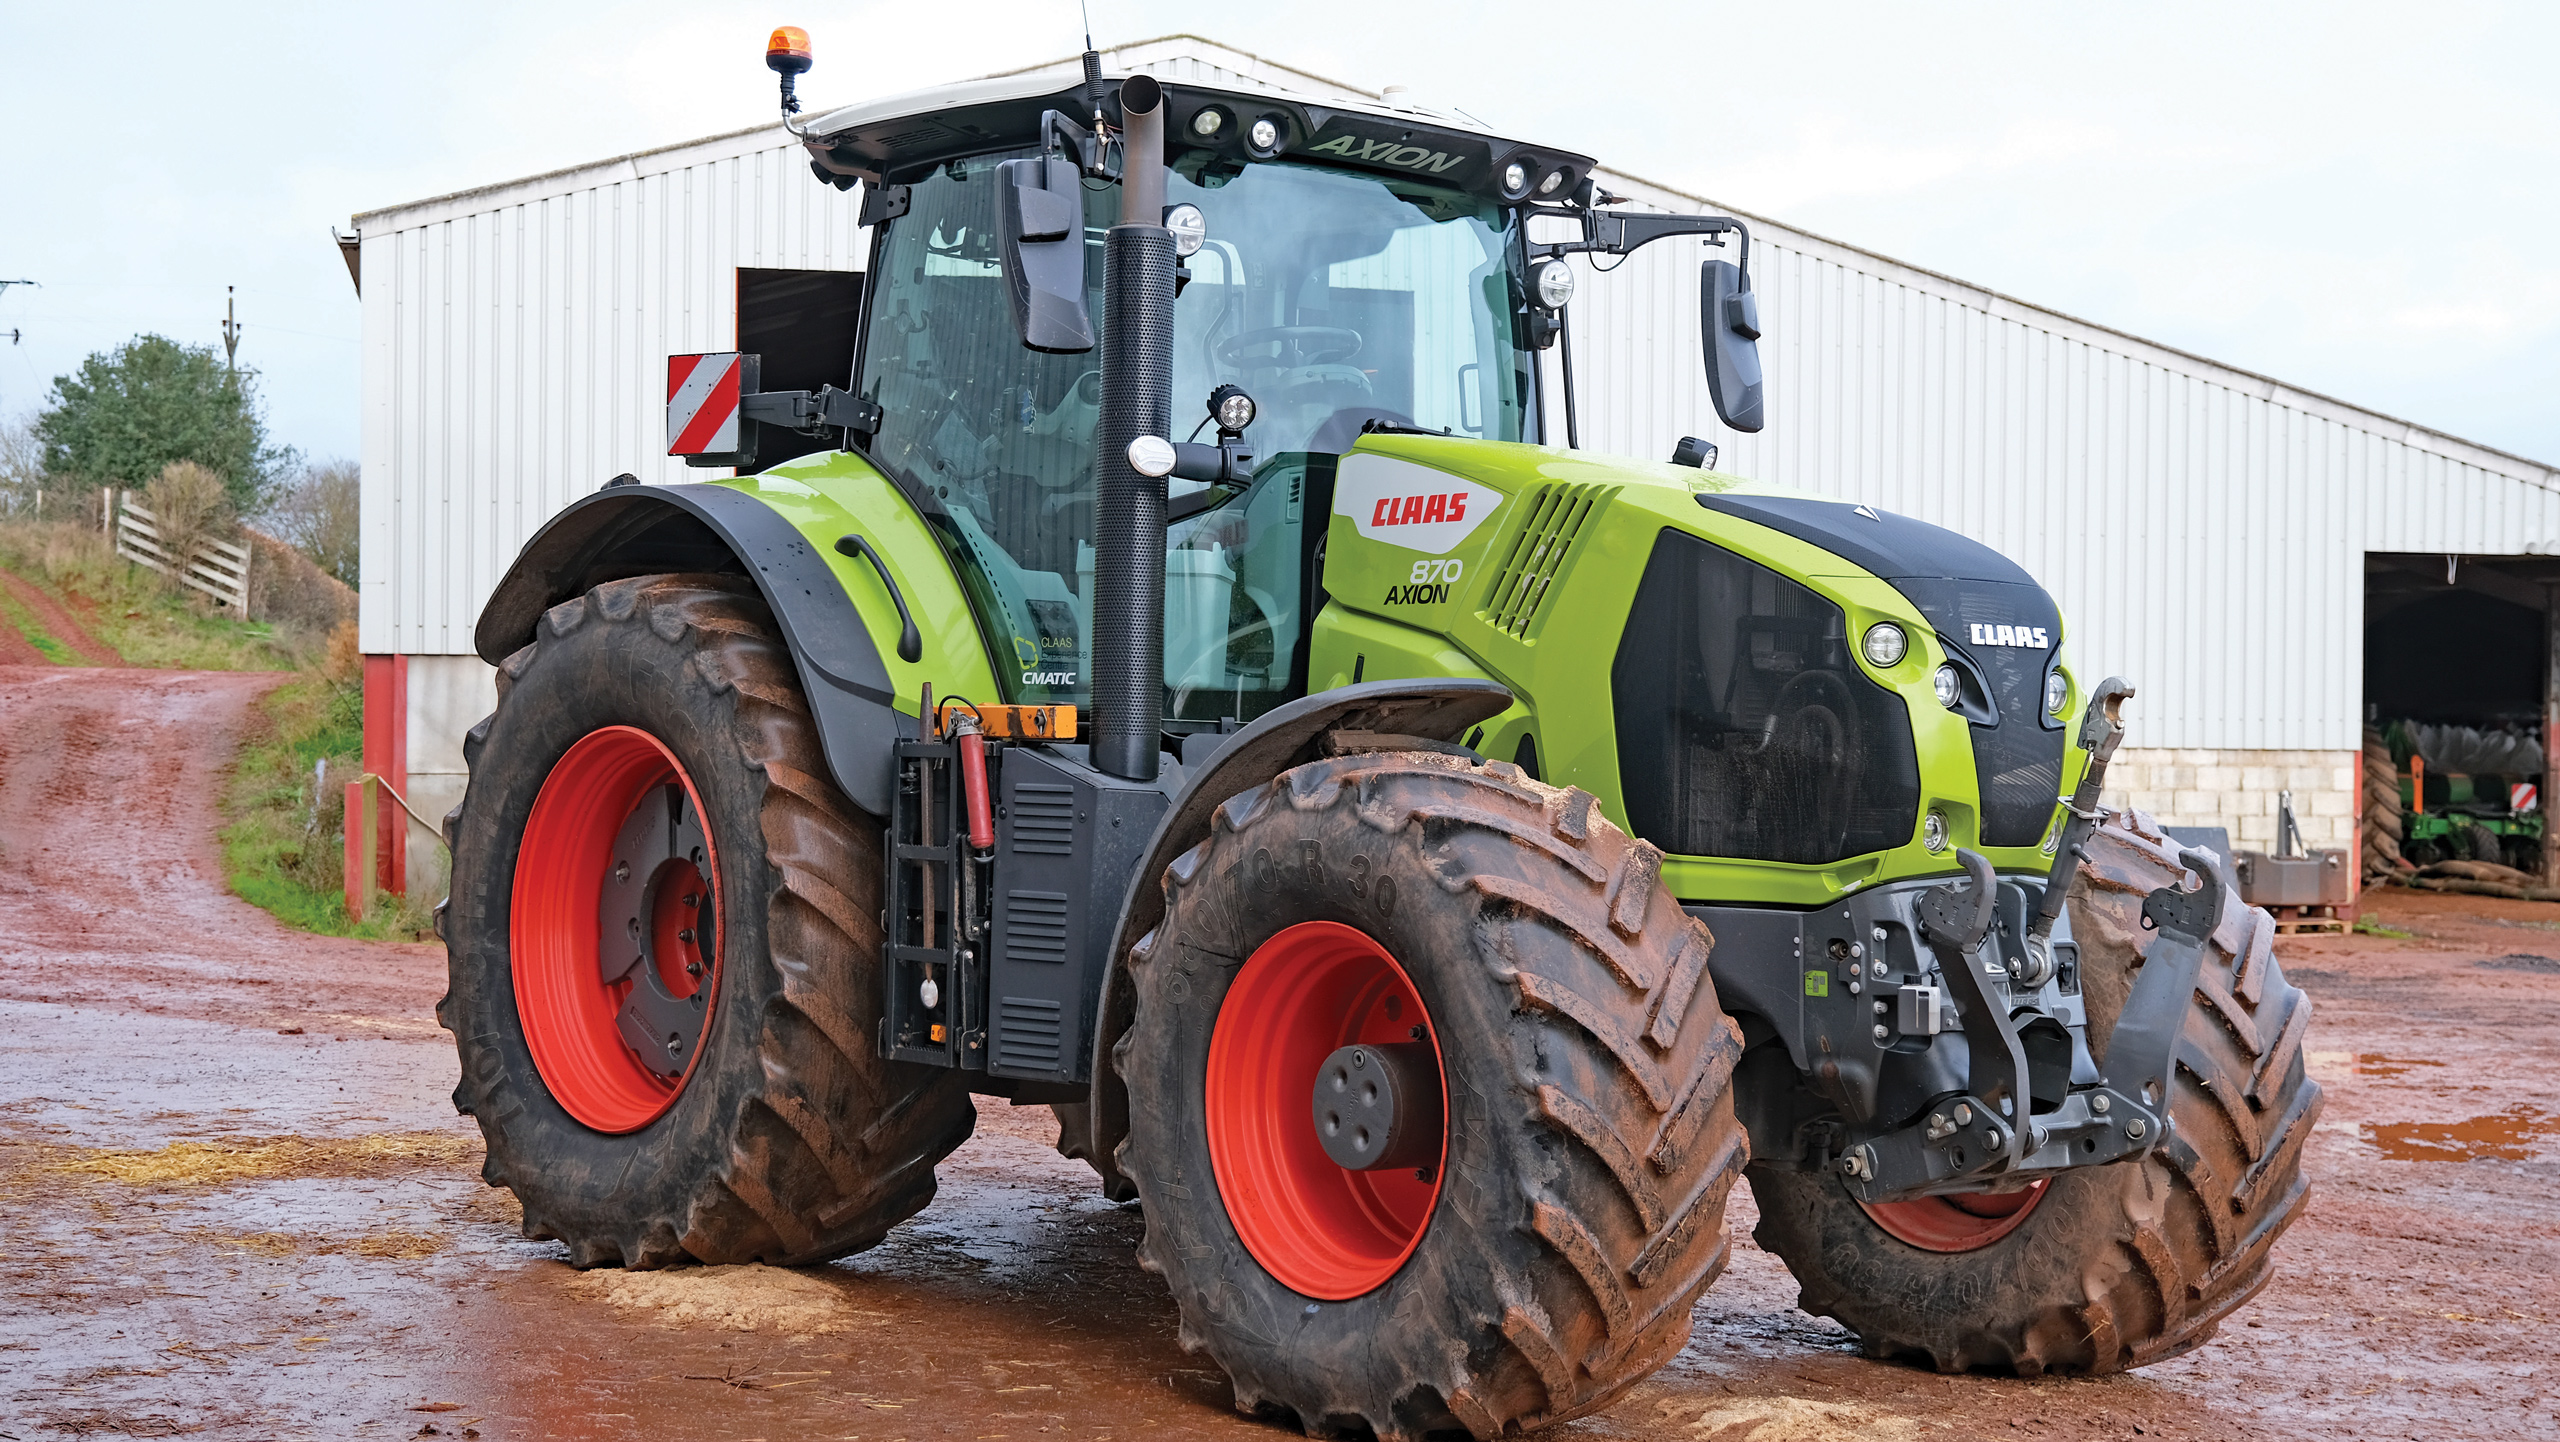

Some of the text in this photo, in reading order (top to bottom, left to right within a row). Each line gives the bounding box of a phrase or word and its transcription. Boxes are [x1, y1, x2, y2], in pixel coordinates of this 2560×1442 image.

[1308, 135, 1466, 173] AXION
[1371, 492, 1469, 527] CLAAS
[1409, 559, 1463, 584] 870
[1383, 584, 1450, 605] AXION
[1041, 637, 1073, 648] CLAAS
[1970, 623, 2049, 649] CLAAS
[1041, 650, 1088, 660] Experience
[1022, 672, 1077, 685] CMATIC
[1299, 838, 1327, 886] R
[1347, 853, 1399, 919] 30
